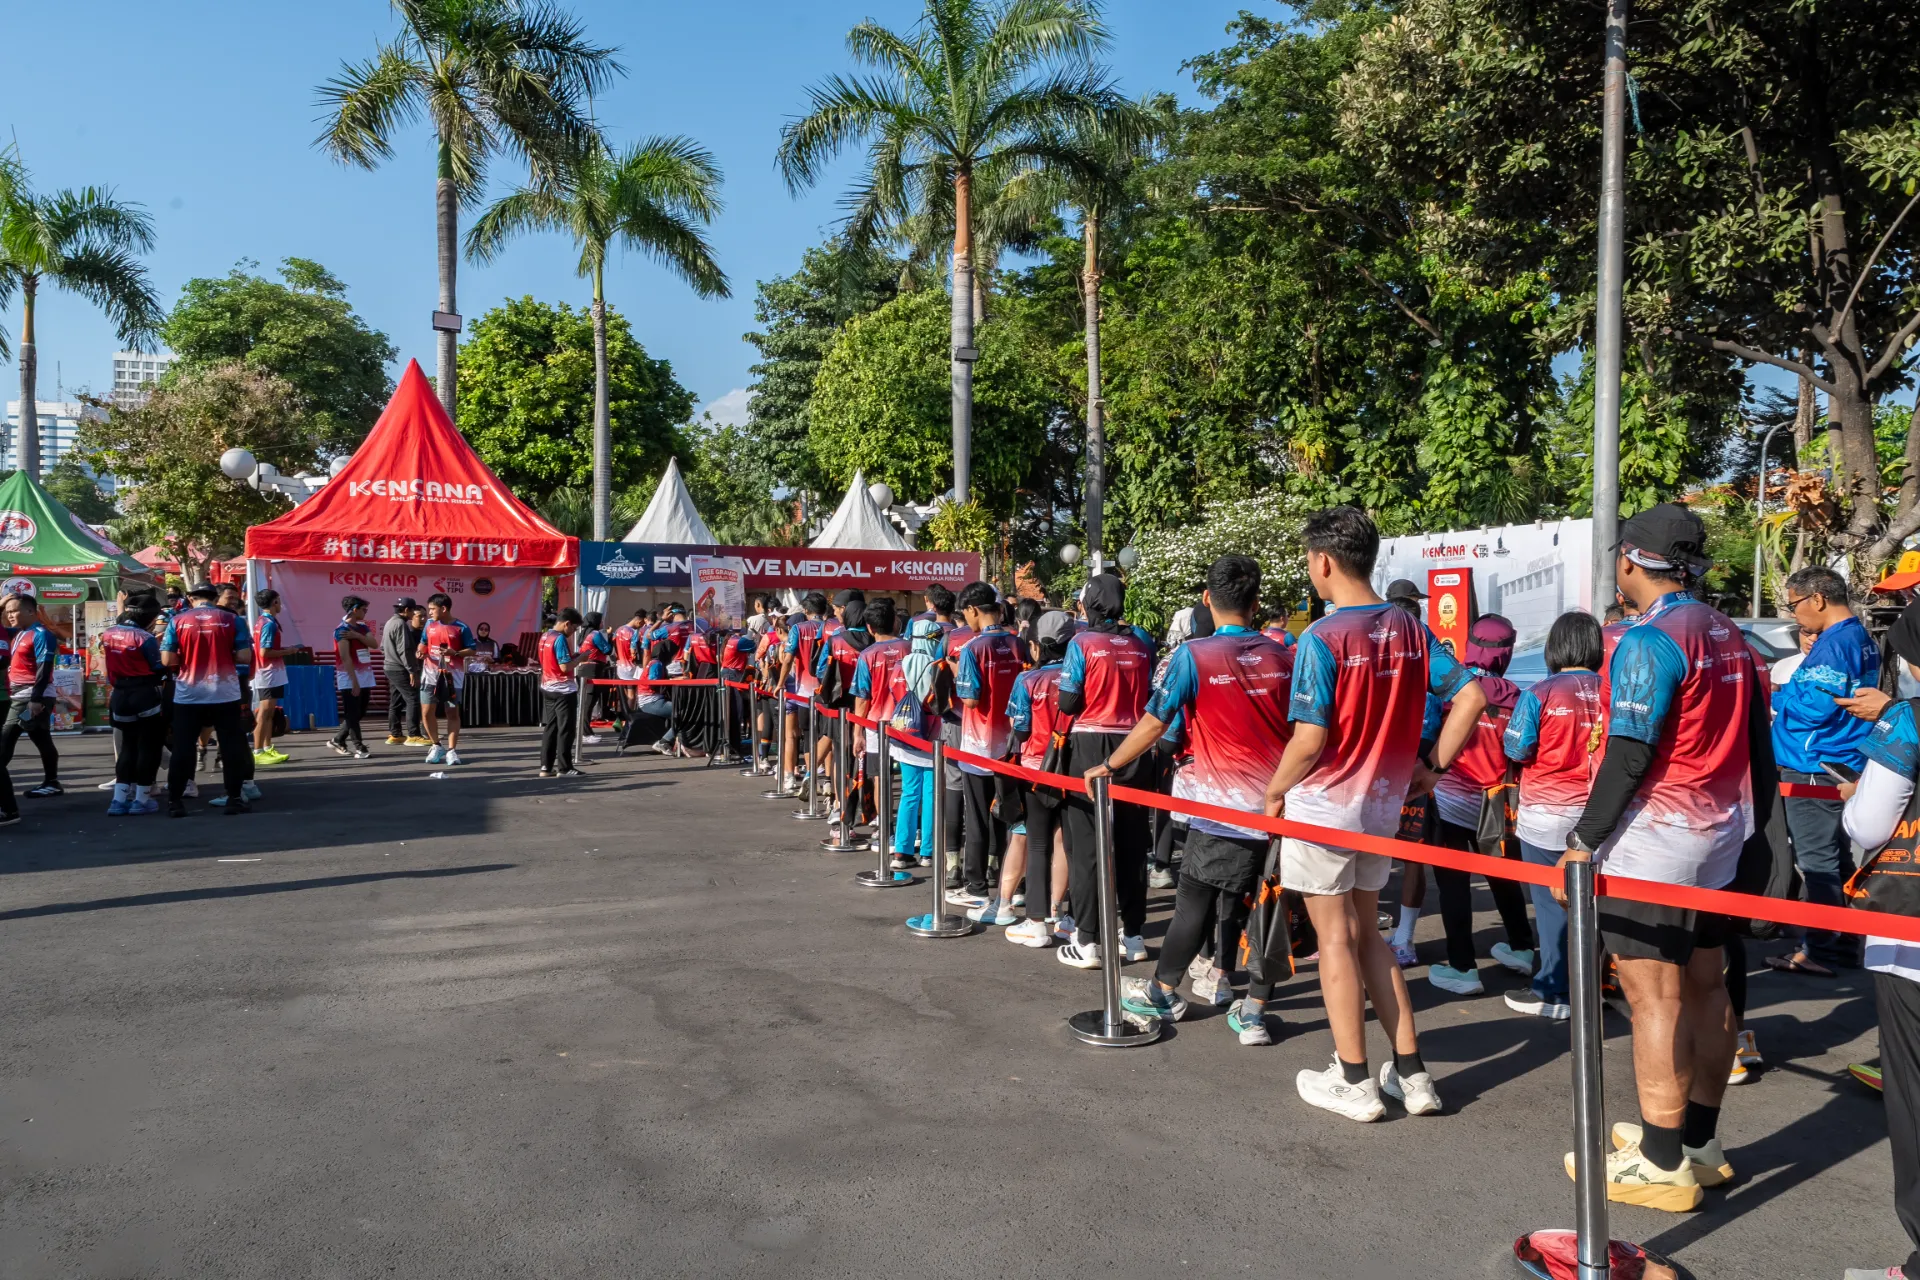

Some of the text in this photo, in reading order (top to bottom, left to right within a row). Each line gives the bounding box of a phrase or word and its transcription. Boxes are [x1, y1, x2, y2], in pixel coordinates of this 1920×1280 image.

[350, 479, 483, 500] KENCANA
[323, 538, 518, 562] #tidakTIPUTIPU
[1422, 544, 1466, 558] KENCANA
[785, 559, 871, 578] MEDAL
[891, 560, 965, 576] KENCANA
[329, 571, 418, 587] KENCANA
